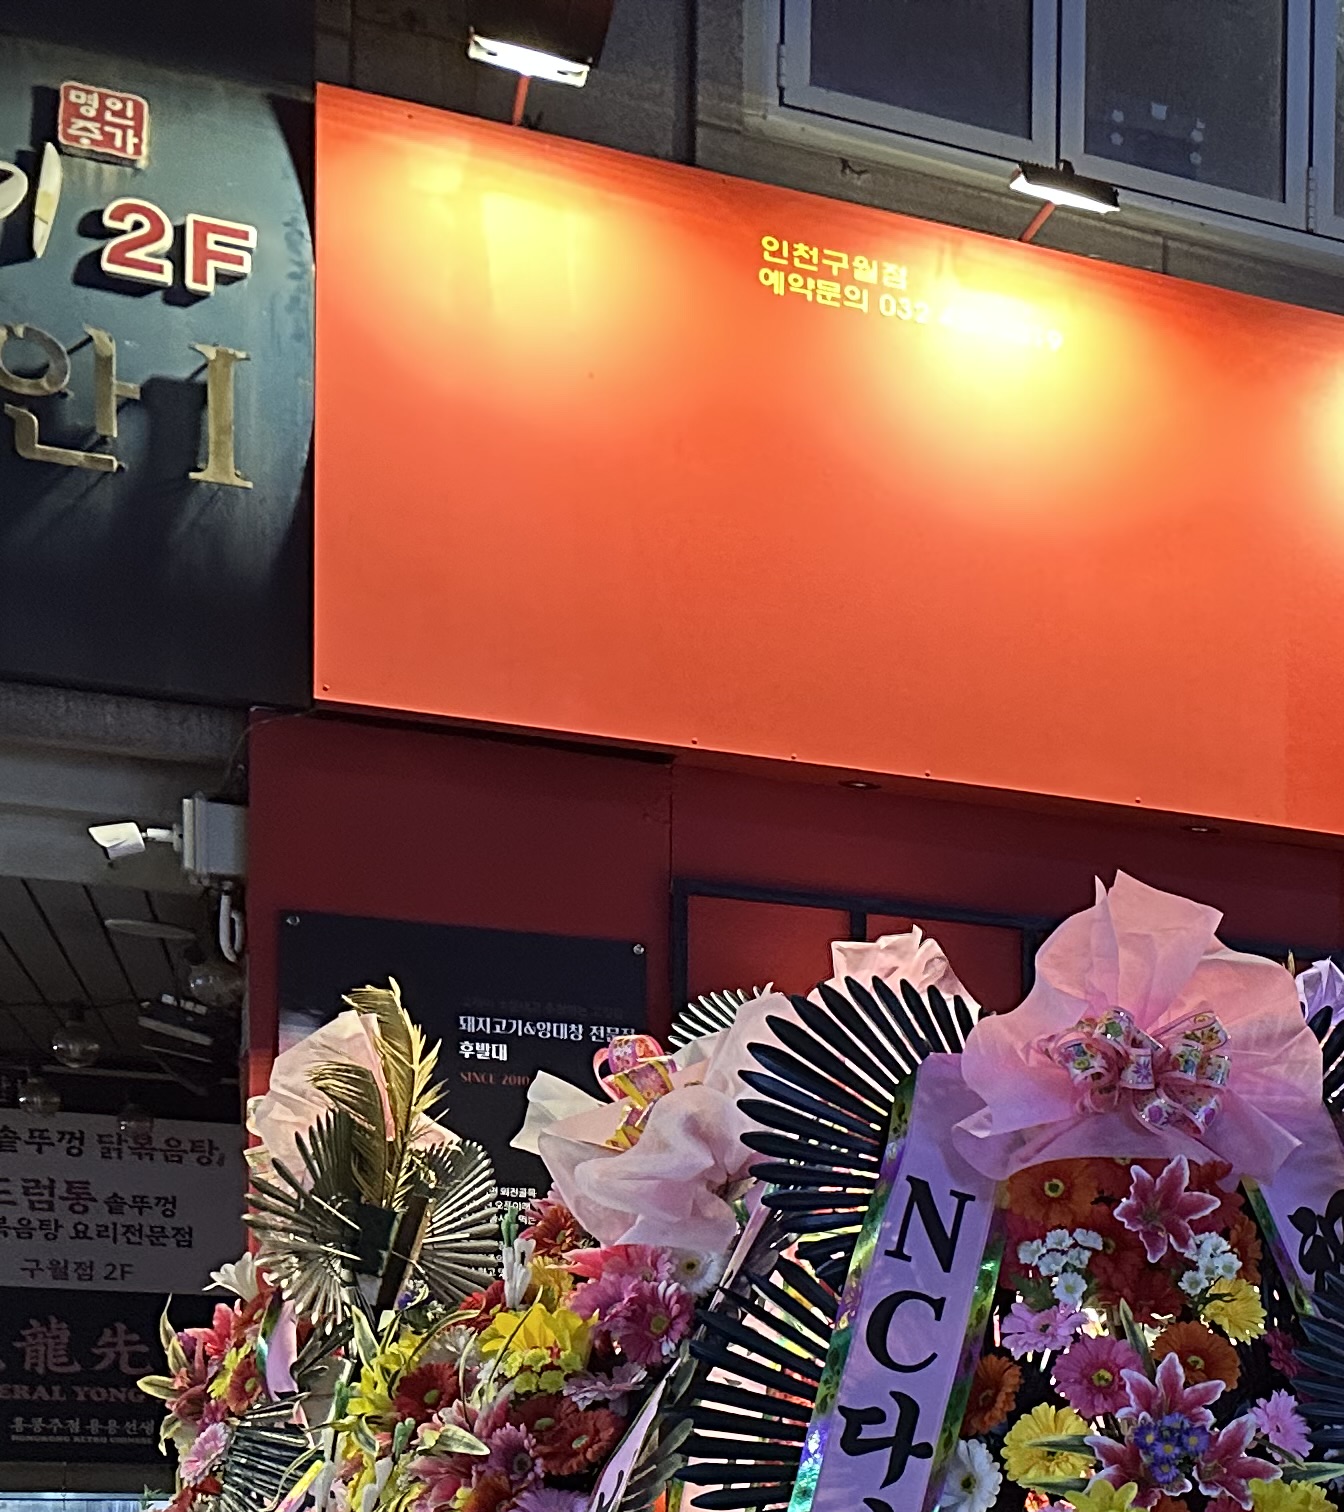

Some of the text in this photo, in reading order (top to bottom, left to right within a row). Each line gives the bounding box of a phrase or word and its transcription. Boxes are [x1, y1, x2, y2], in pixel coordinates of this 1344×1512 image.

[68, 90, 134, 126] 명인
[101, 197, 258, 296] 2F
[761, 234, 909, 291] 인천구월점
[758, 267, 932, 324] 예약문의 032
[459, 1040, 508, 1061] 후발대
[104, 1192, 178, 1219] 솥뚜껑
[69, 1221, 194, 1249] 요리전문점
[20, 1258, 134, 1282] 구월점 2F
